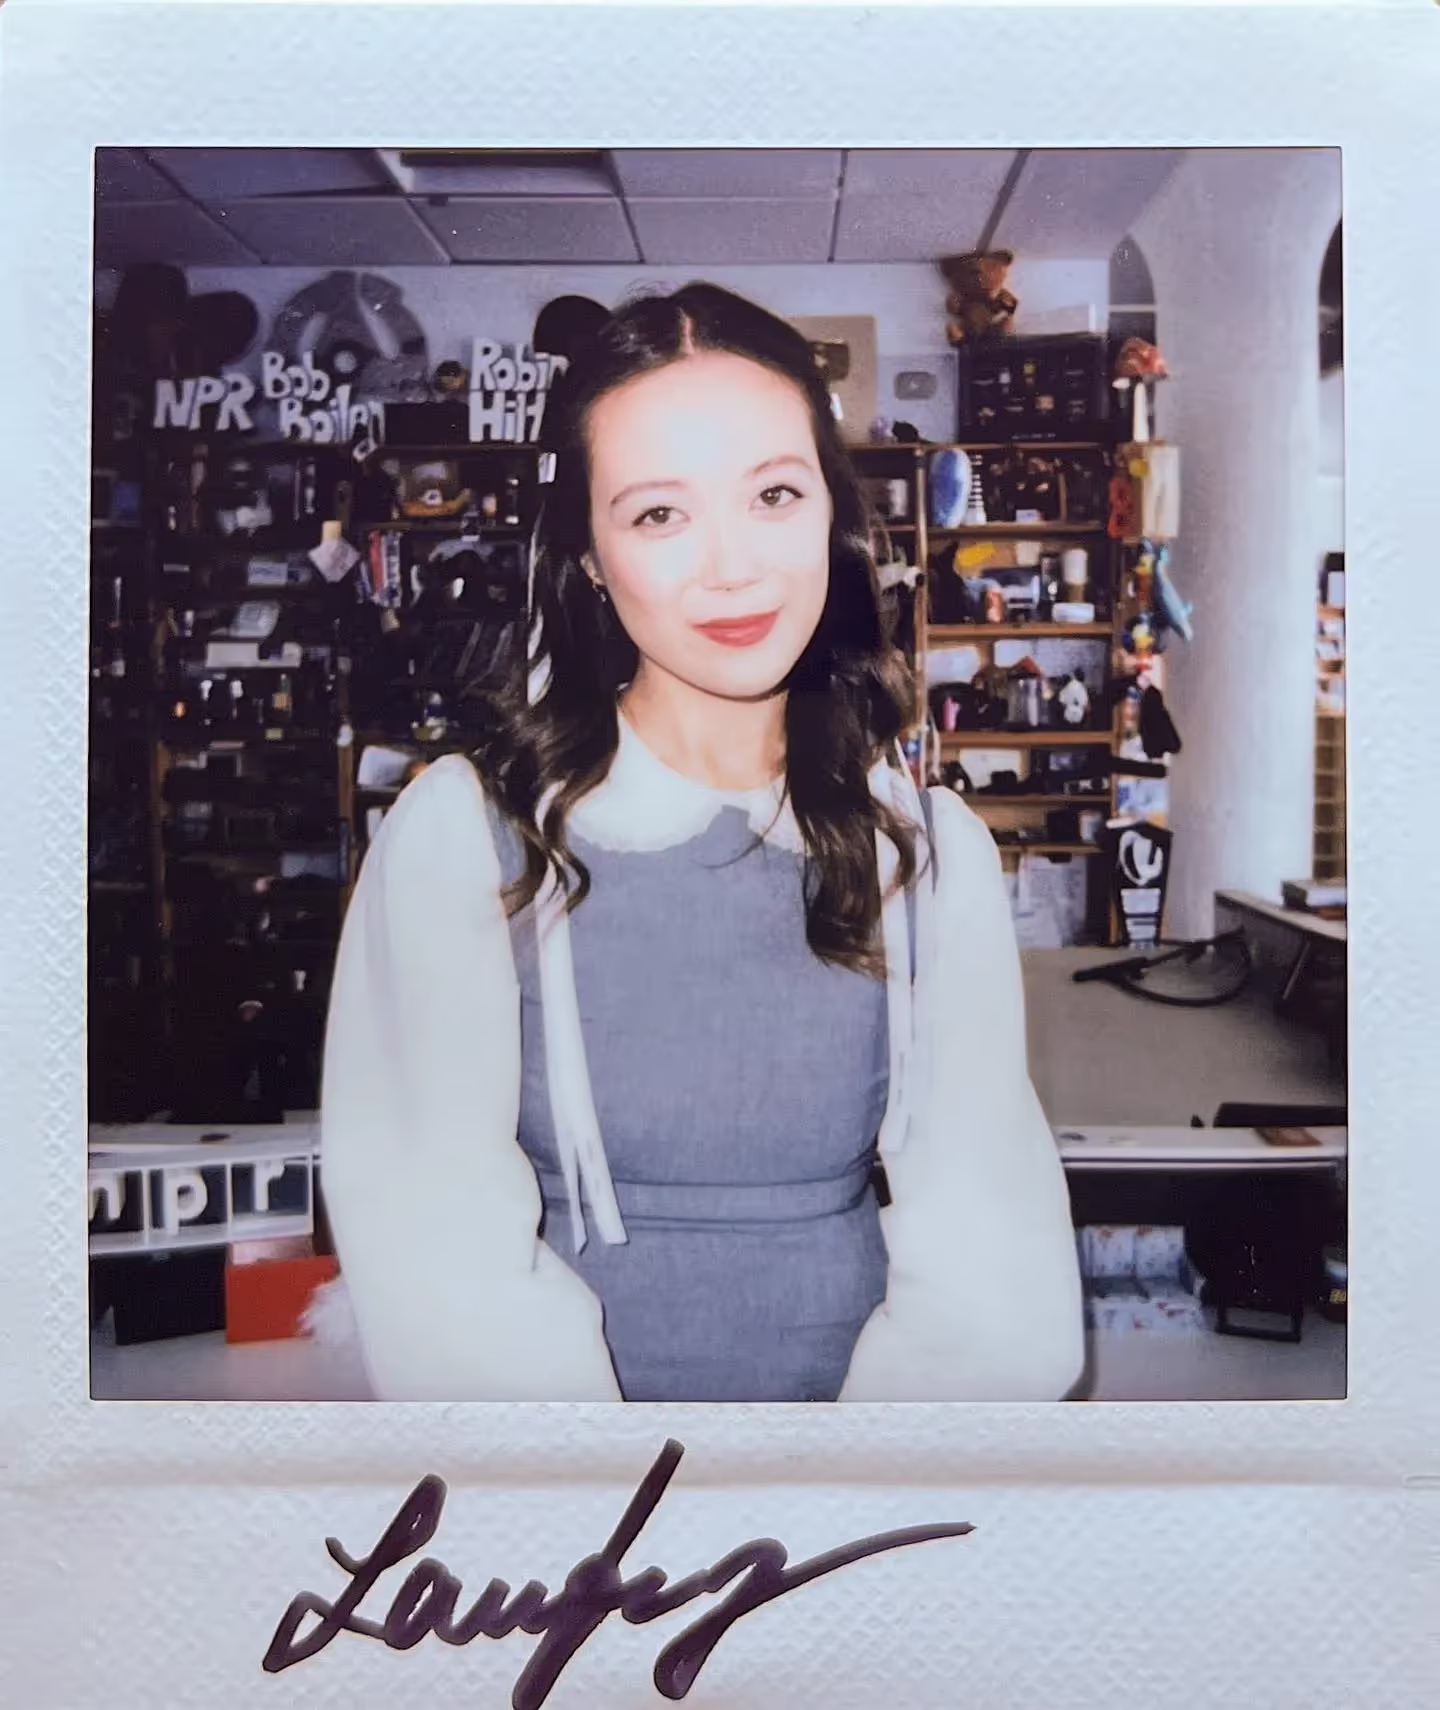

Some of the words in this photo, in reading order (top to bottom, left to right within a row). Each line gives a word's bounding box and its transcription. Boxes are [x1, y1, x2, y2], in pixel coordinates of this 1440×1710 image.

[153, 373, 254, 431] NPR
[263, 351, 331, 401] Bob
[88, 1158, 285, 1236] npr
